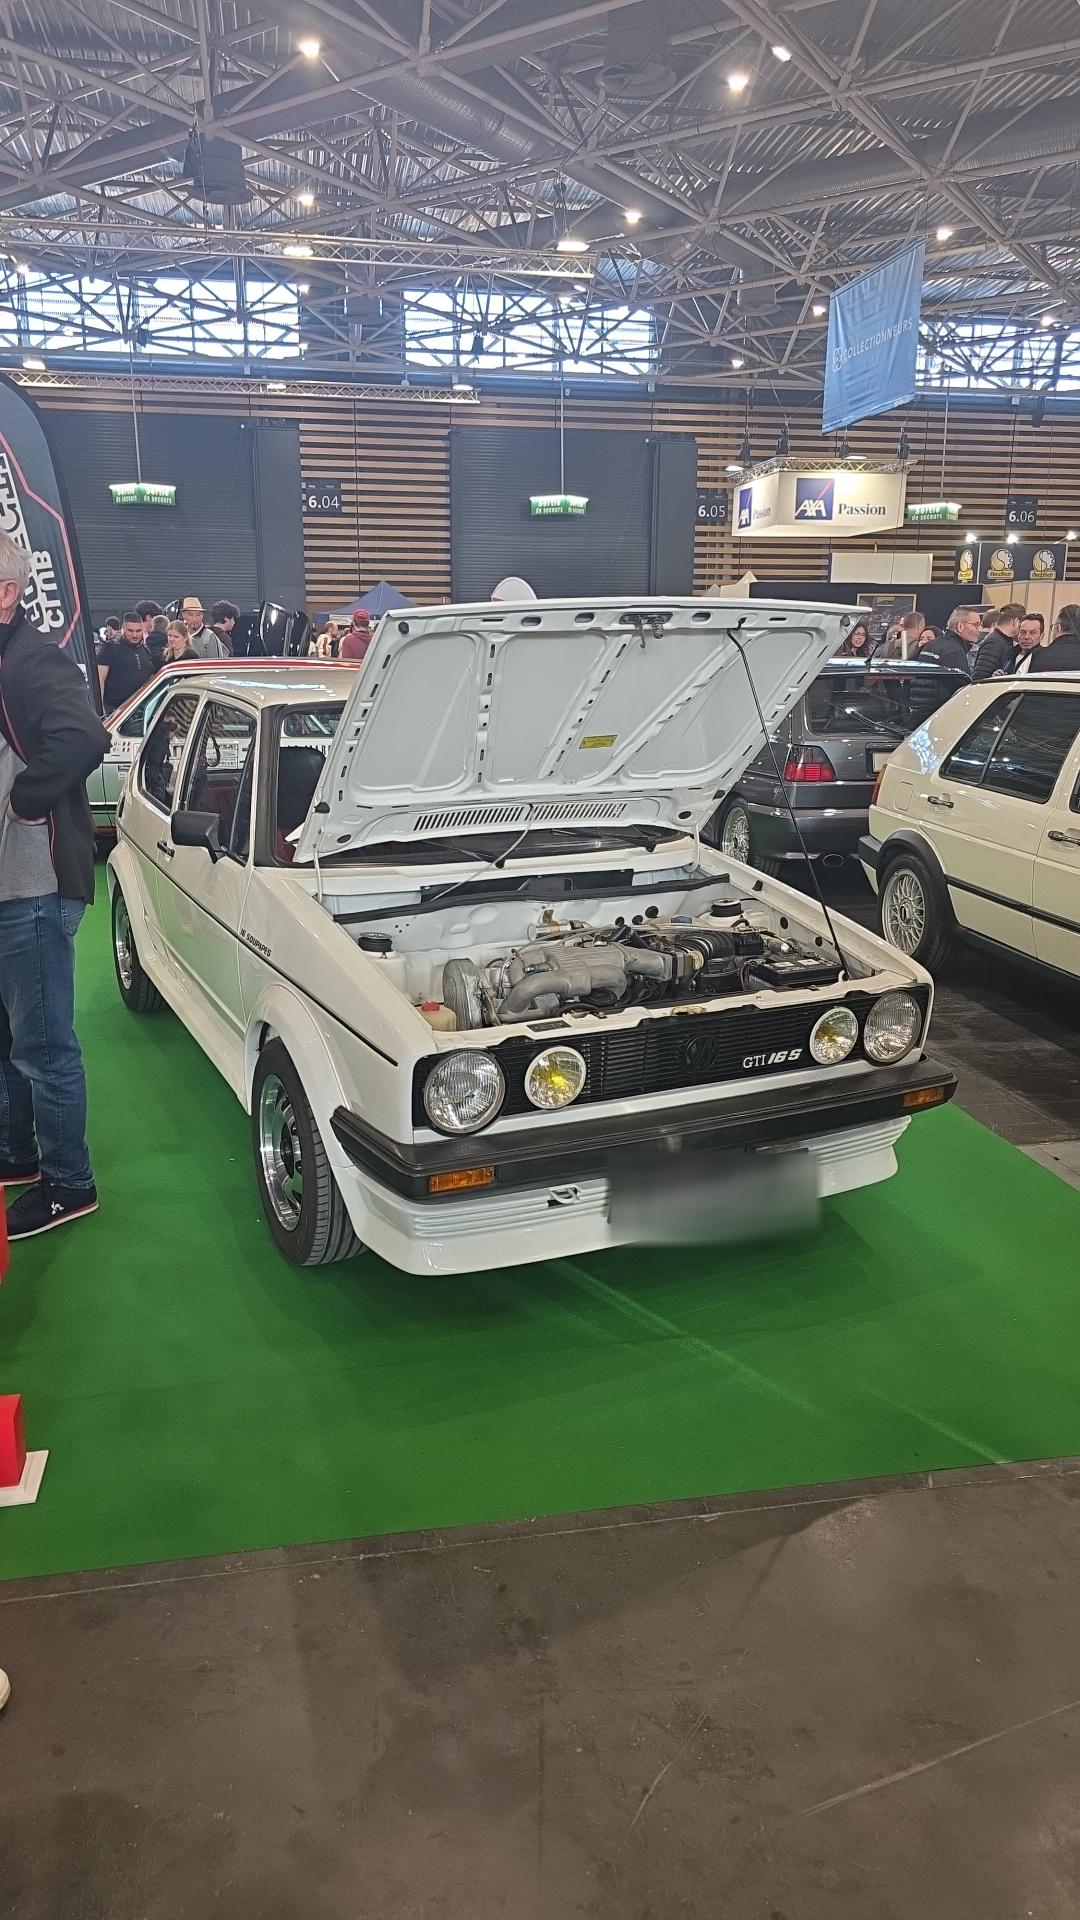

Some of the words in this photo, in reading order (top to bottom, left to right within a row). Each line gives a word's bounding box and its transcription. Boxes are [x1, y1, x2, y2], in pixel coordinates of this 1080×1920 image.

[309, 495, 340, 508] 6.04
[793, 500, 827, 517] AXA
[838, 503, 886, 516] Passion
[698, 505, 726, 518] 6.05
[1008, 511, 1035, 523] 6.06
[246, 933, 272, 958] SOUPAPES
[742, 1054, 767, 1069] GTI
